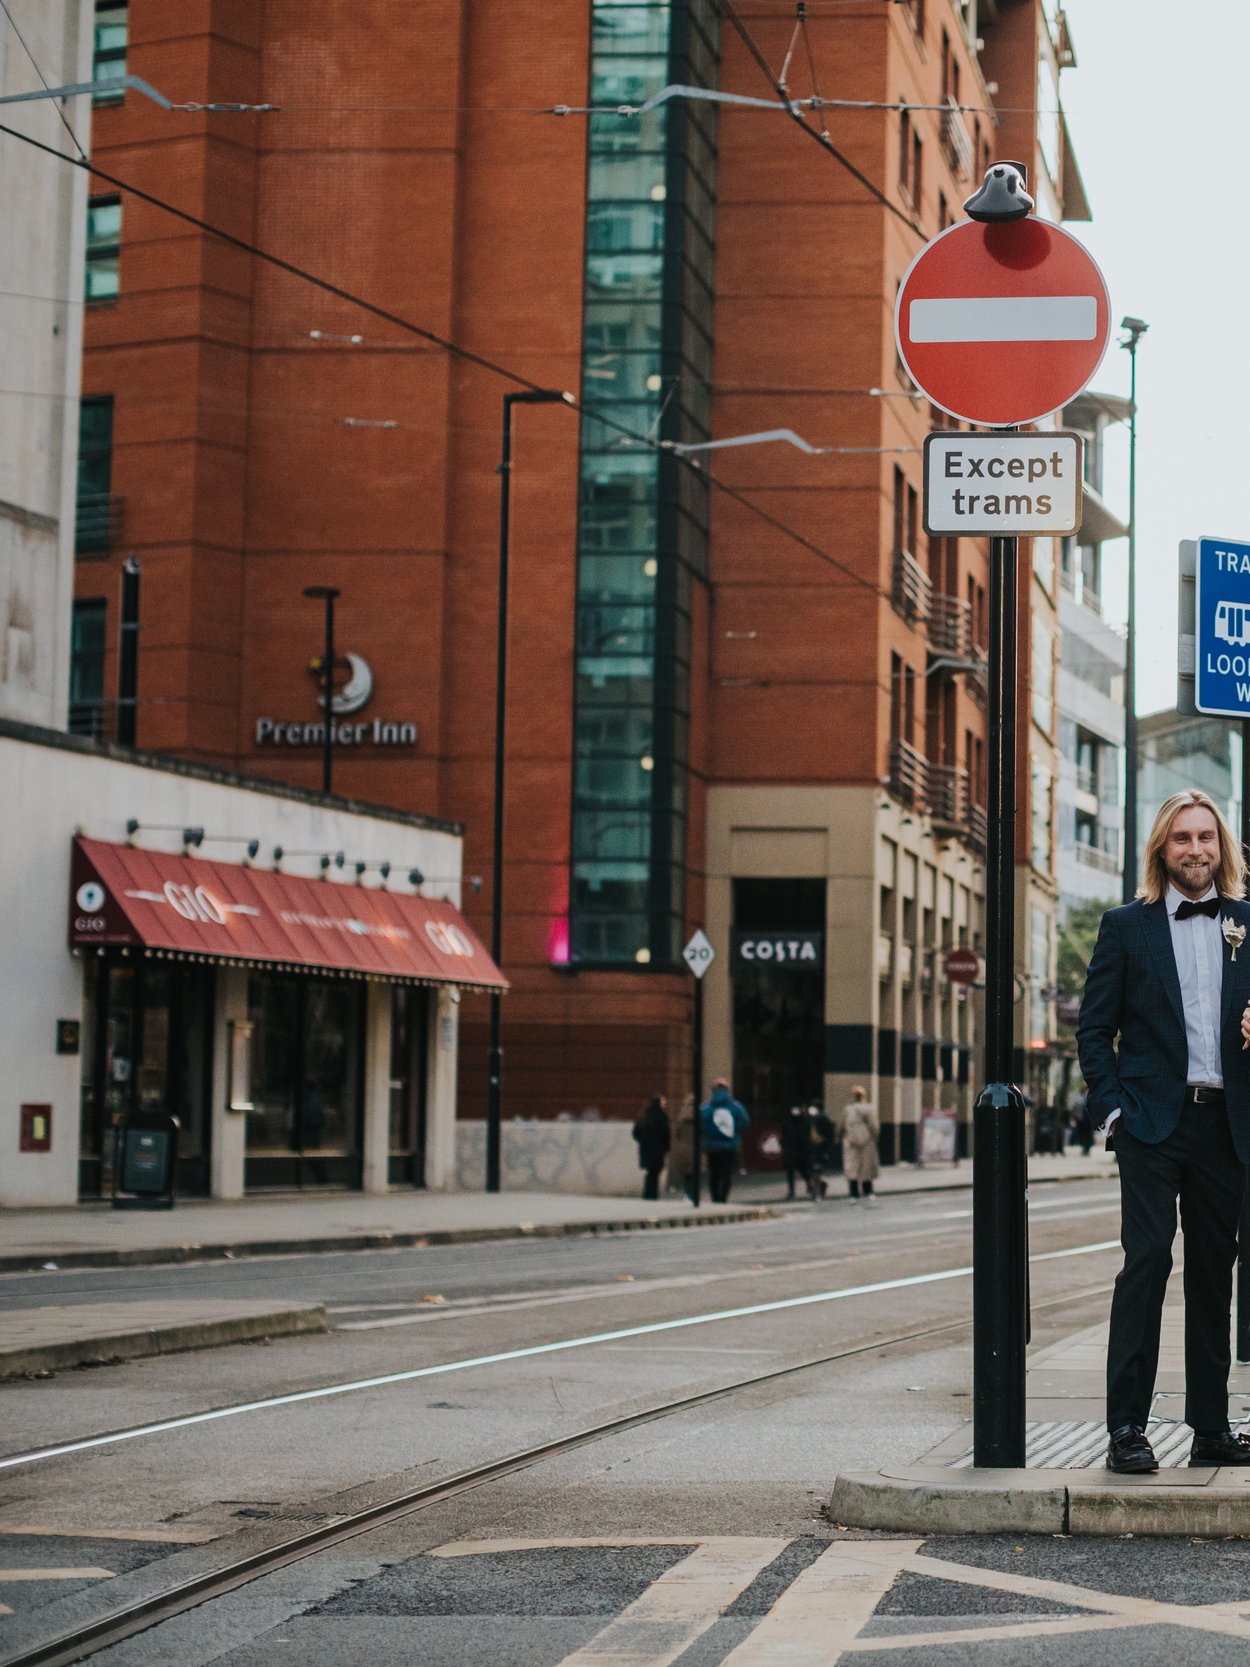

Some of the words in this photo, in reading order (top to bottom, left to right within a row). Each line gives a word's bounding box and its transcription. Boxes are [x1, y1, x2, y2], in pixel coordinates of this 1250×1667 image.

[945, 452, 1063, 483] Except
[952, 488, 1052, 515] trams
[256, 717, 367, 744] Premier
[373, 718, 416, 743] Inn
[689, 948, 710, 961] 20
[740, 941, 816, 962] COSTA
